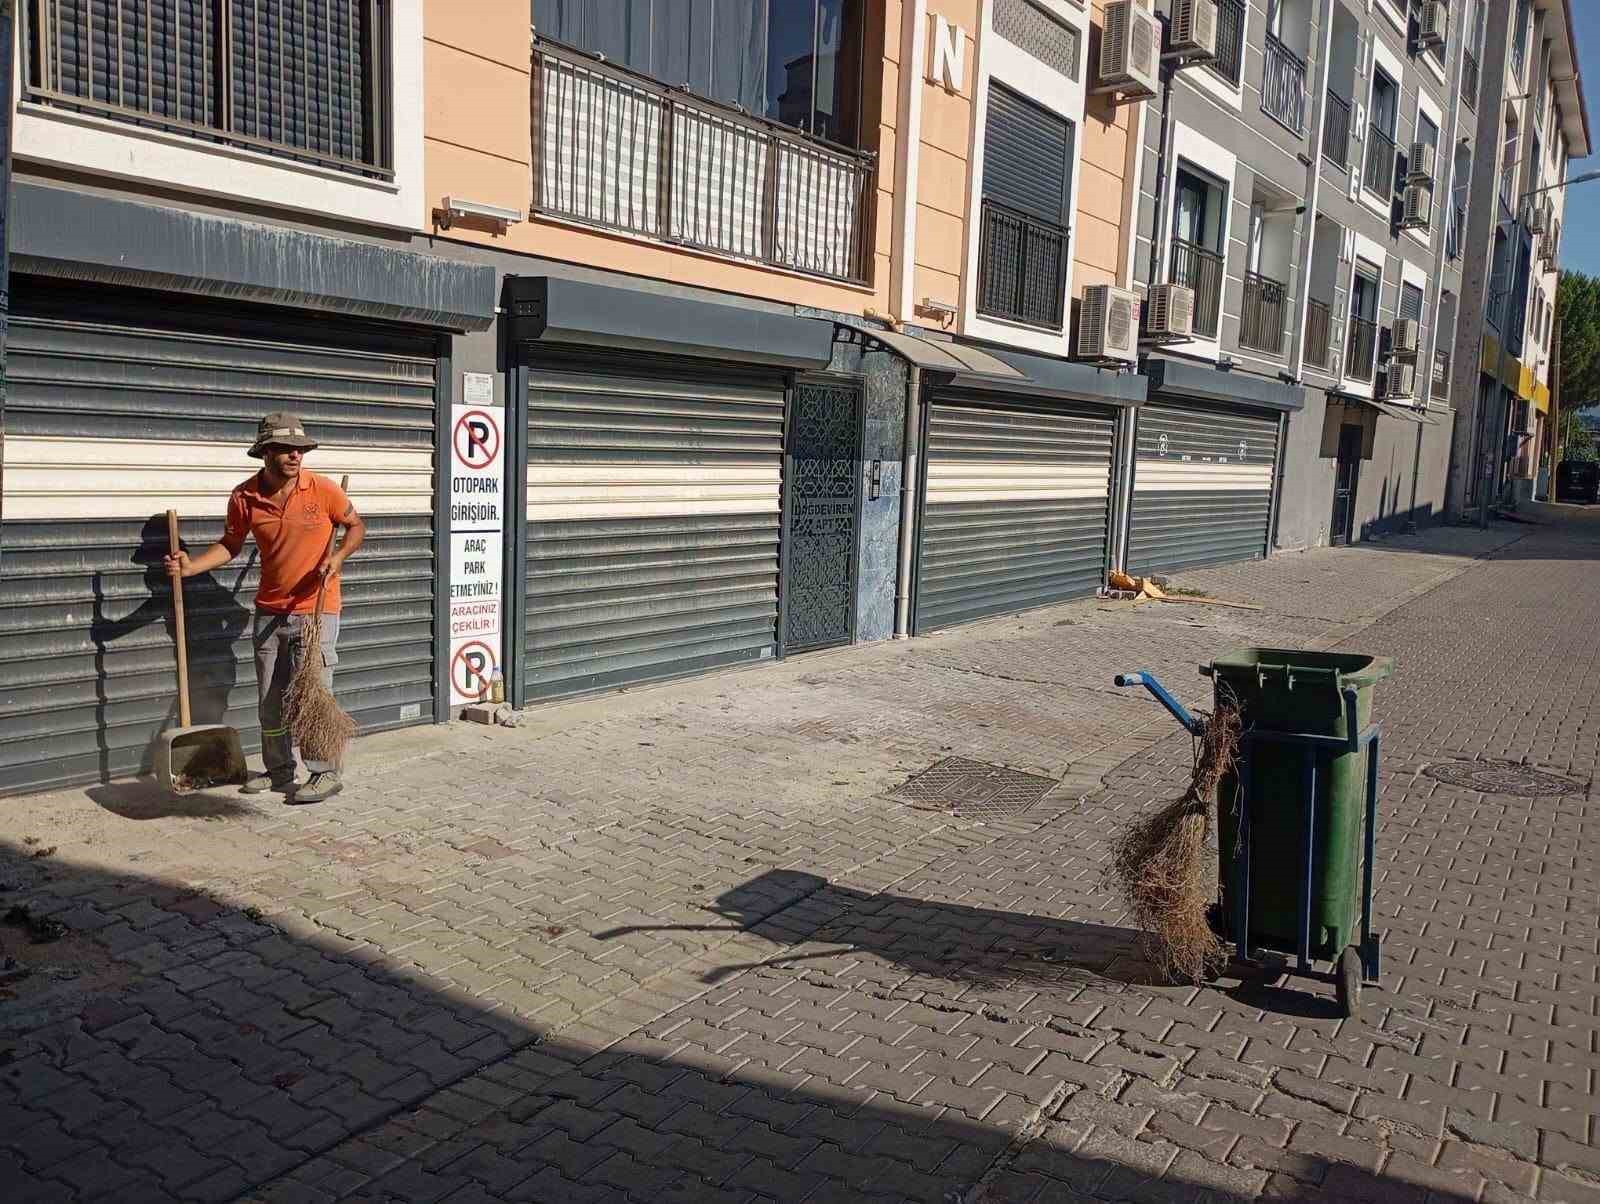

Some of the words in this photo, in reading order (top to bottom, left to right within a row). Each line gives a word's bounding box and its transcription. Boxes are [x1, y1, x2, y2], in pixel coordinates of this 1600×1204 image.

[930, 13, 966, 95] N
[453, 476, 499, 494] OTOPARK
[451, 502, 500, 524] GİRİŞİDİR.
[464, 539, 487, 555] ARAÇ
[464, 561, 486, 575] PARK
[451, 603, 497, 618] ARACINIZ
